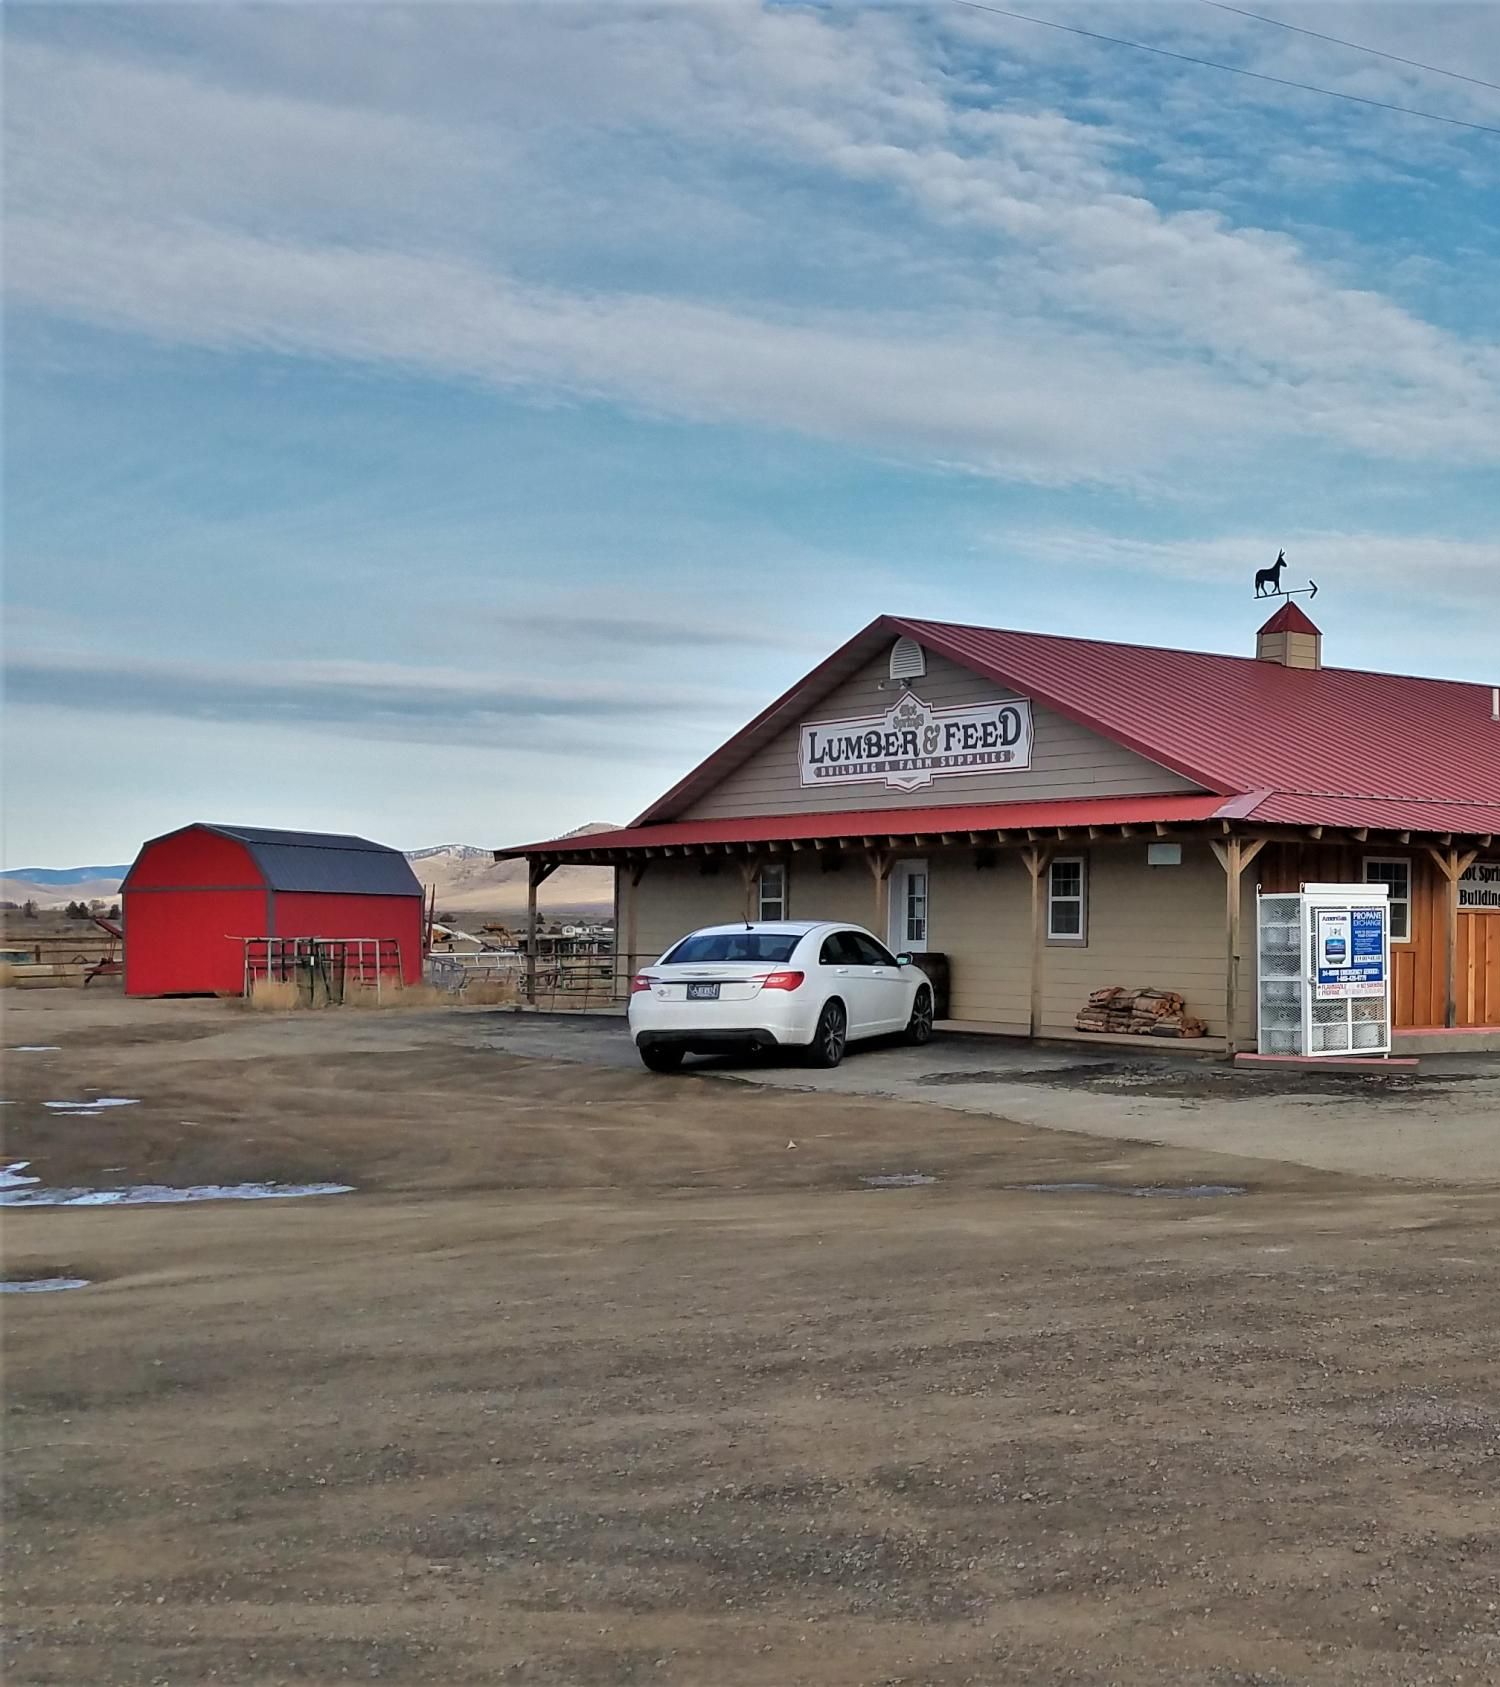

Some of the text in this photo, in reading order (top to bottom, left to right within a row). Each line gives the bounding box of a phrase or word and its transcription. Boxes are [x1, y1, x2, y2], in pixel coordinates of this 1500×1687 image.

[809, 706, 1021, 764] LUMBER & FEED
[820, 764, 877, 777] BUILDING
[900, 758, 932, 770] FARM
[940, 752, 1006, 766] SUPPLIES
[1353, 911, 1382, 920] PROPANE
